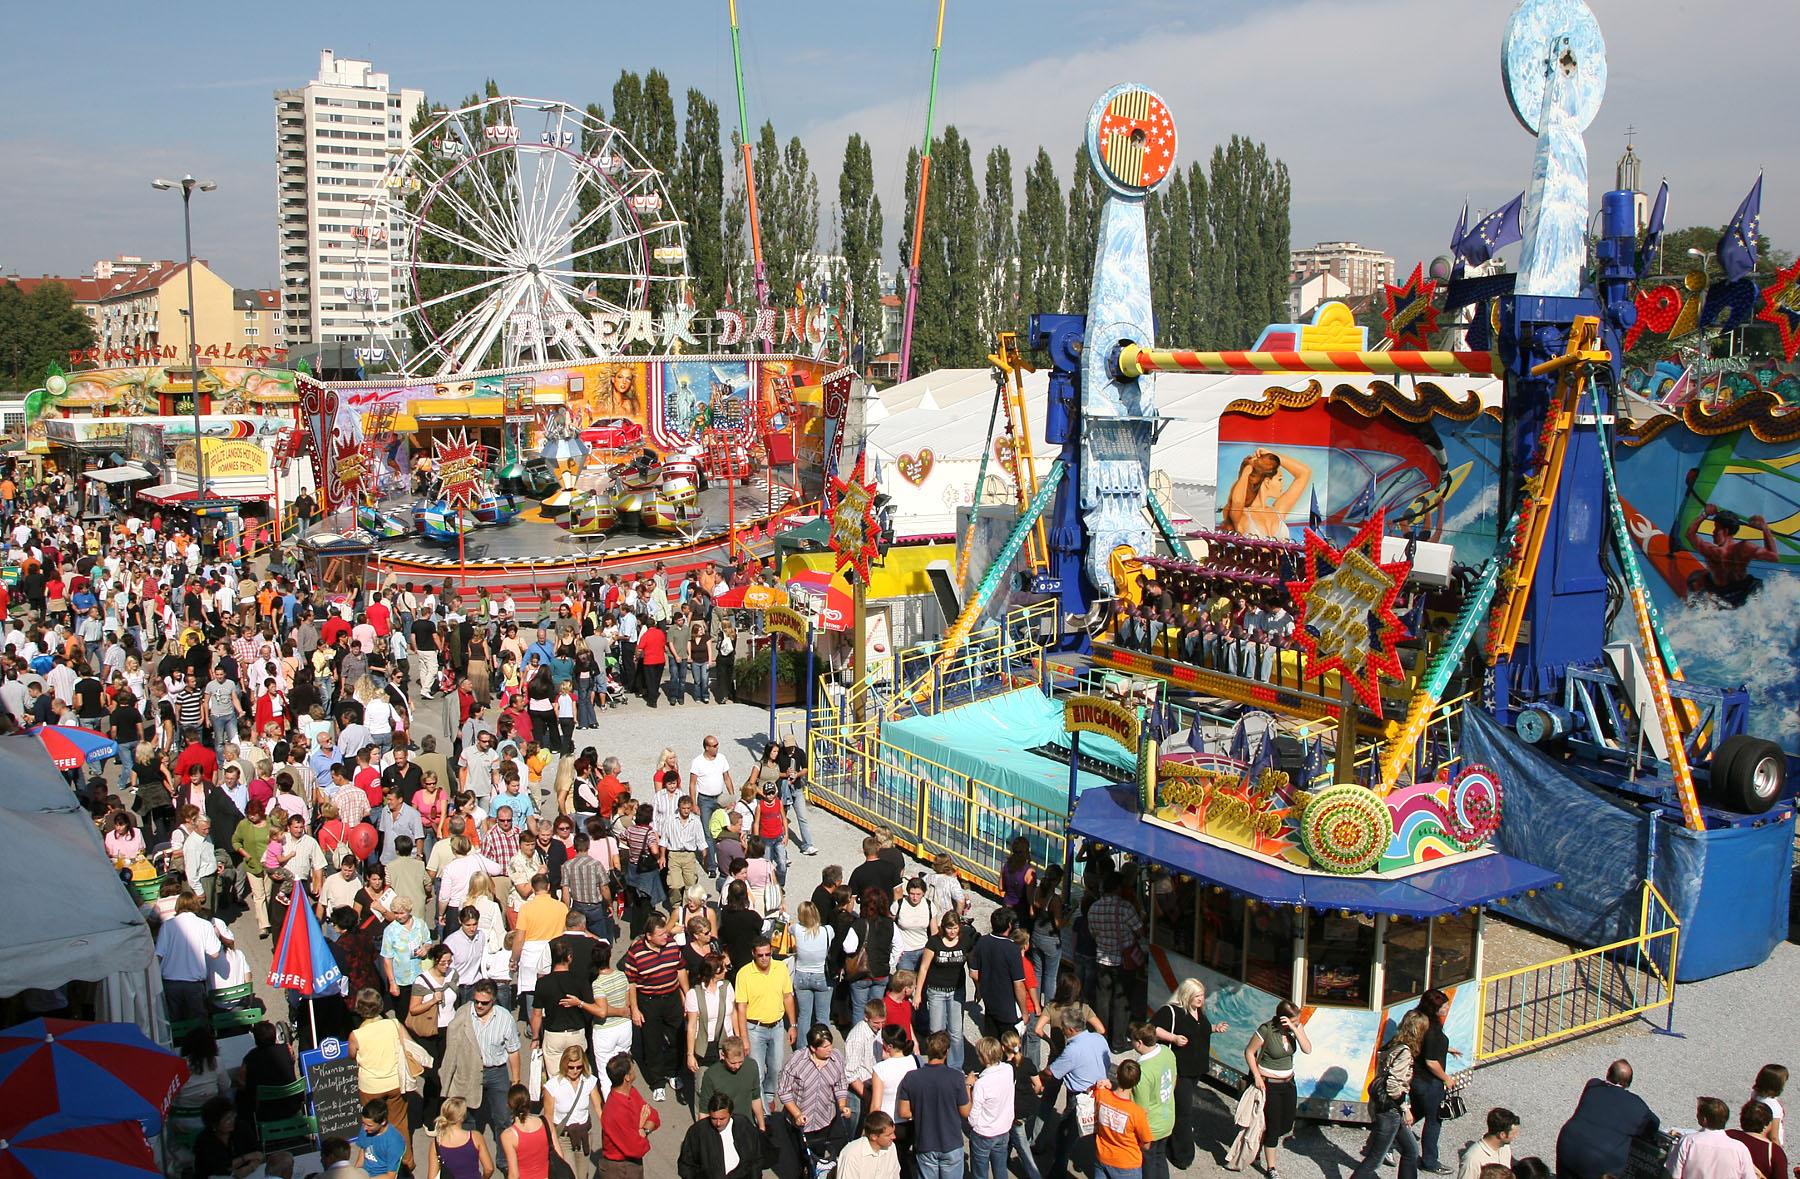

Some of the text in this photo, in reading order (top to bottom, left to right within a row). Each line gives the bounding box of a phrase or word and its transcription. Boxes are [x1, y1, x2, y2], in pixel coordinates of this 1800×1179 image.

[510, 305, 701, 347] BREAK
[69, 345, 178, 366] DRACHEN
[769, 612, 802, 635] AUSGANG
[1072, 705, 1129, 739] EINGANG
